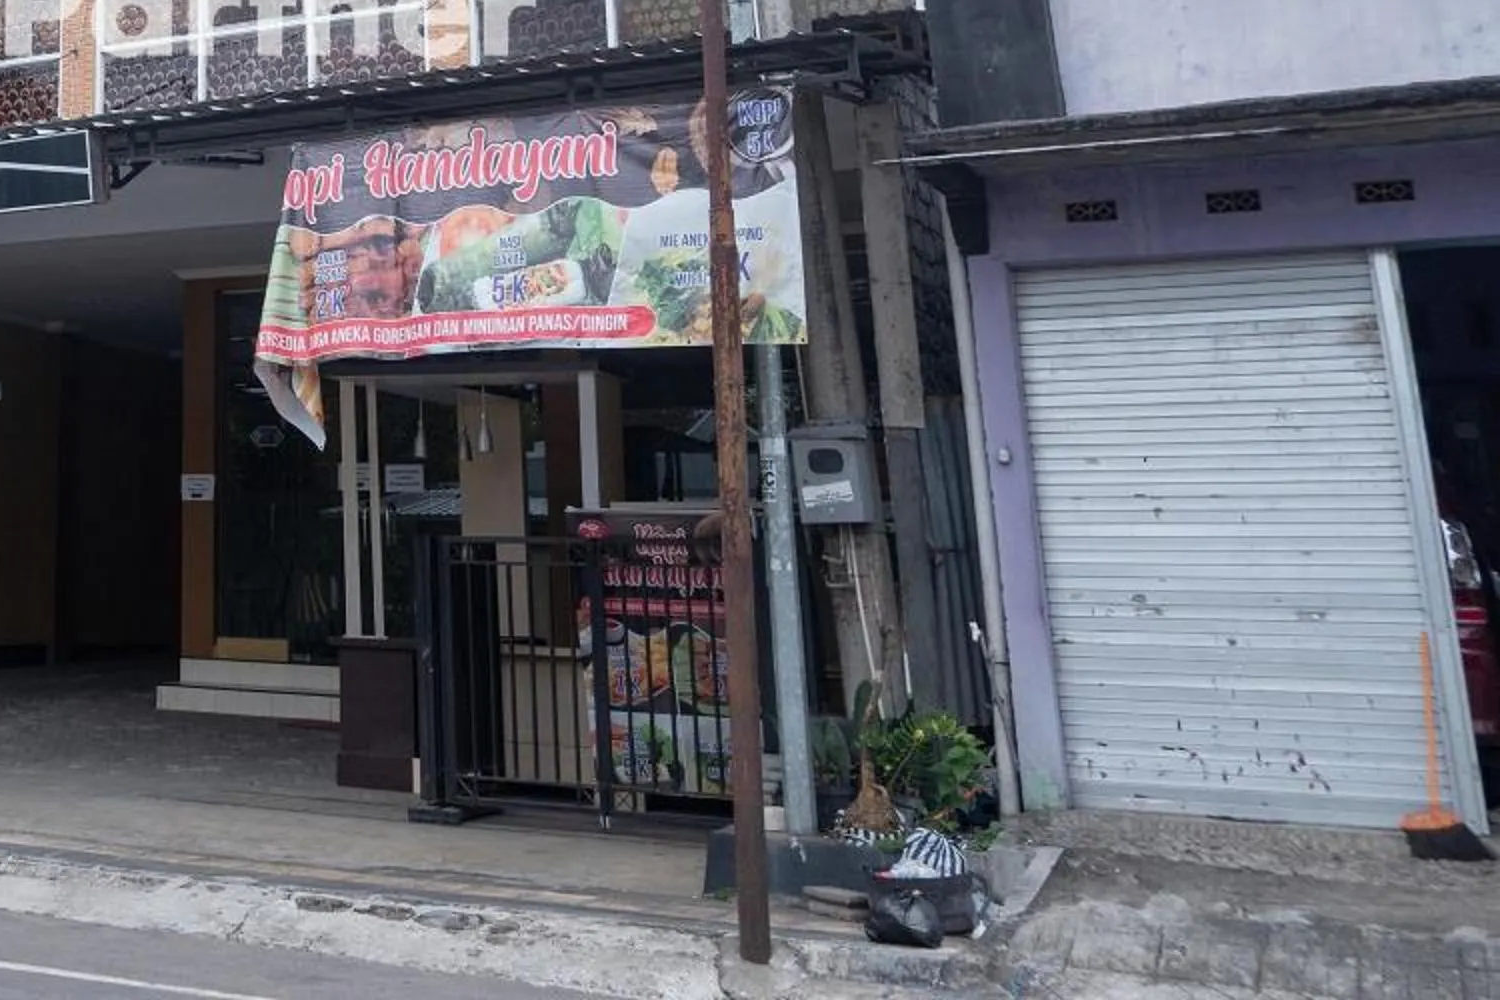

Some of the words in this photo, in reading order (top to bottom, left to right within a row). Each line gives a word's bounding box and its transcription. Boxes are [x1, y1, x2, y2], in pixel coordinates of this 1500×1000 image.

[737, 99, 782, 126] KOPI
[284, 153, 344, 224] opi
[364, 122, 619, 202] Handayani
[660, 233, 678, 248] MIE
[681, 232, 709, 248] ANEK
[258, 332, 306, 352] ERSEDIA
[331, 324, 371, 344] ANEKA
[433, 319, 460, 337] DAN
